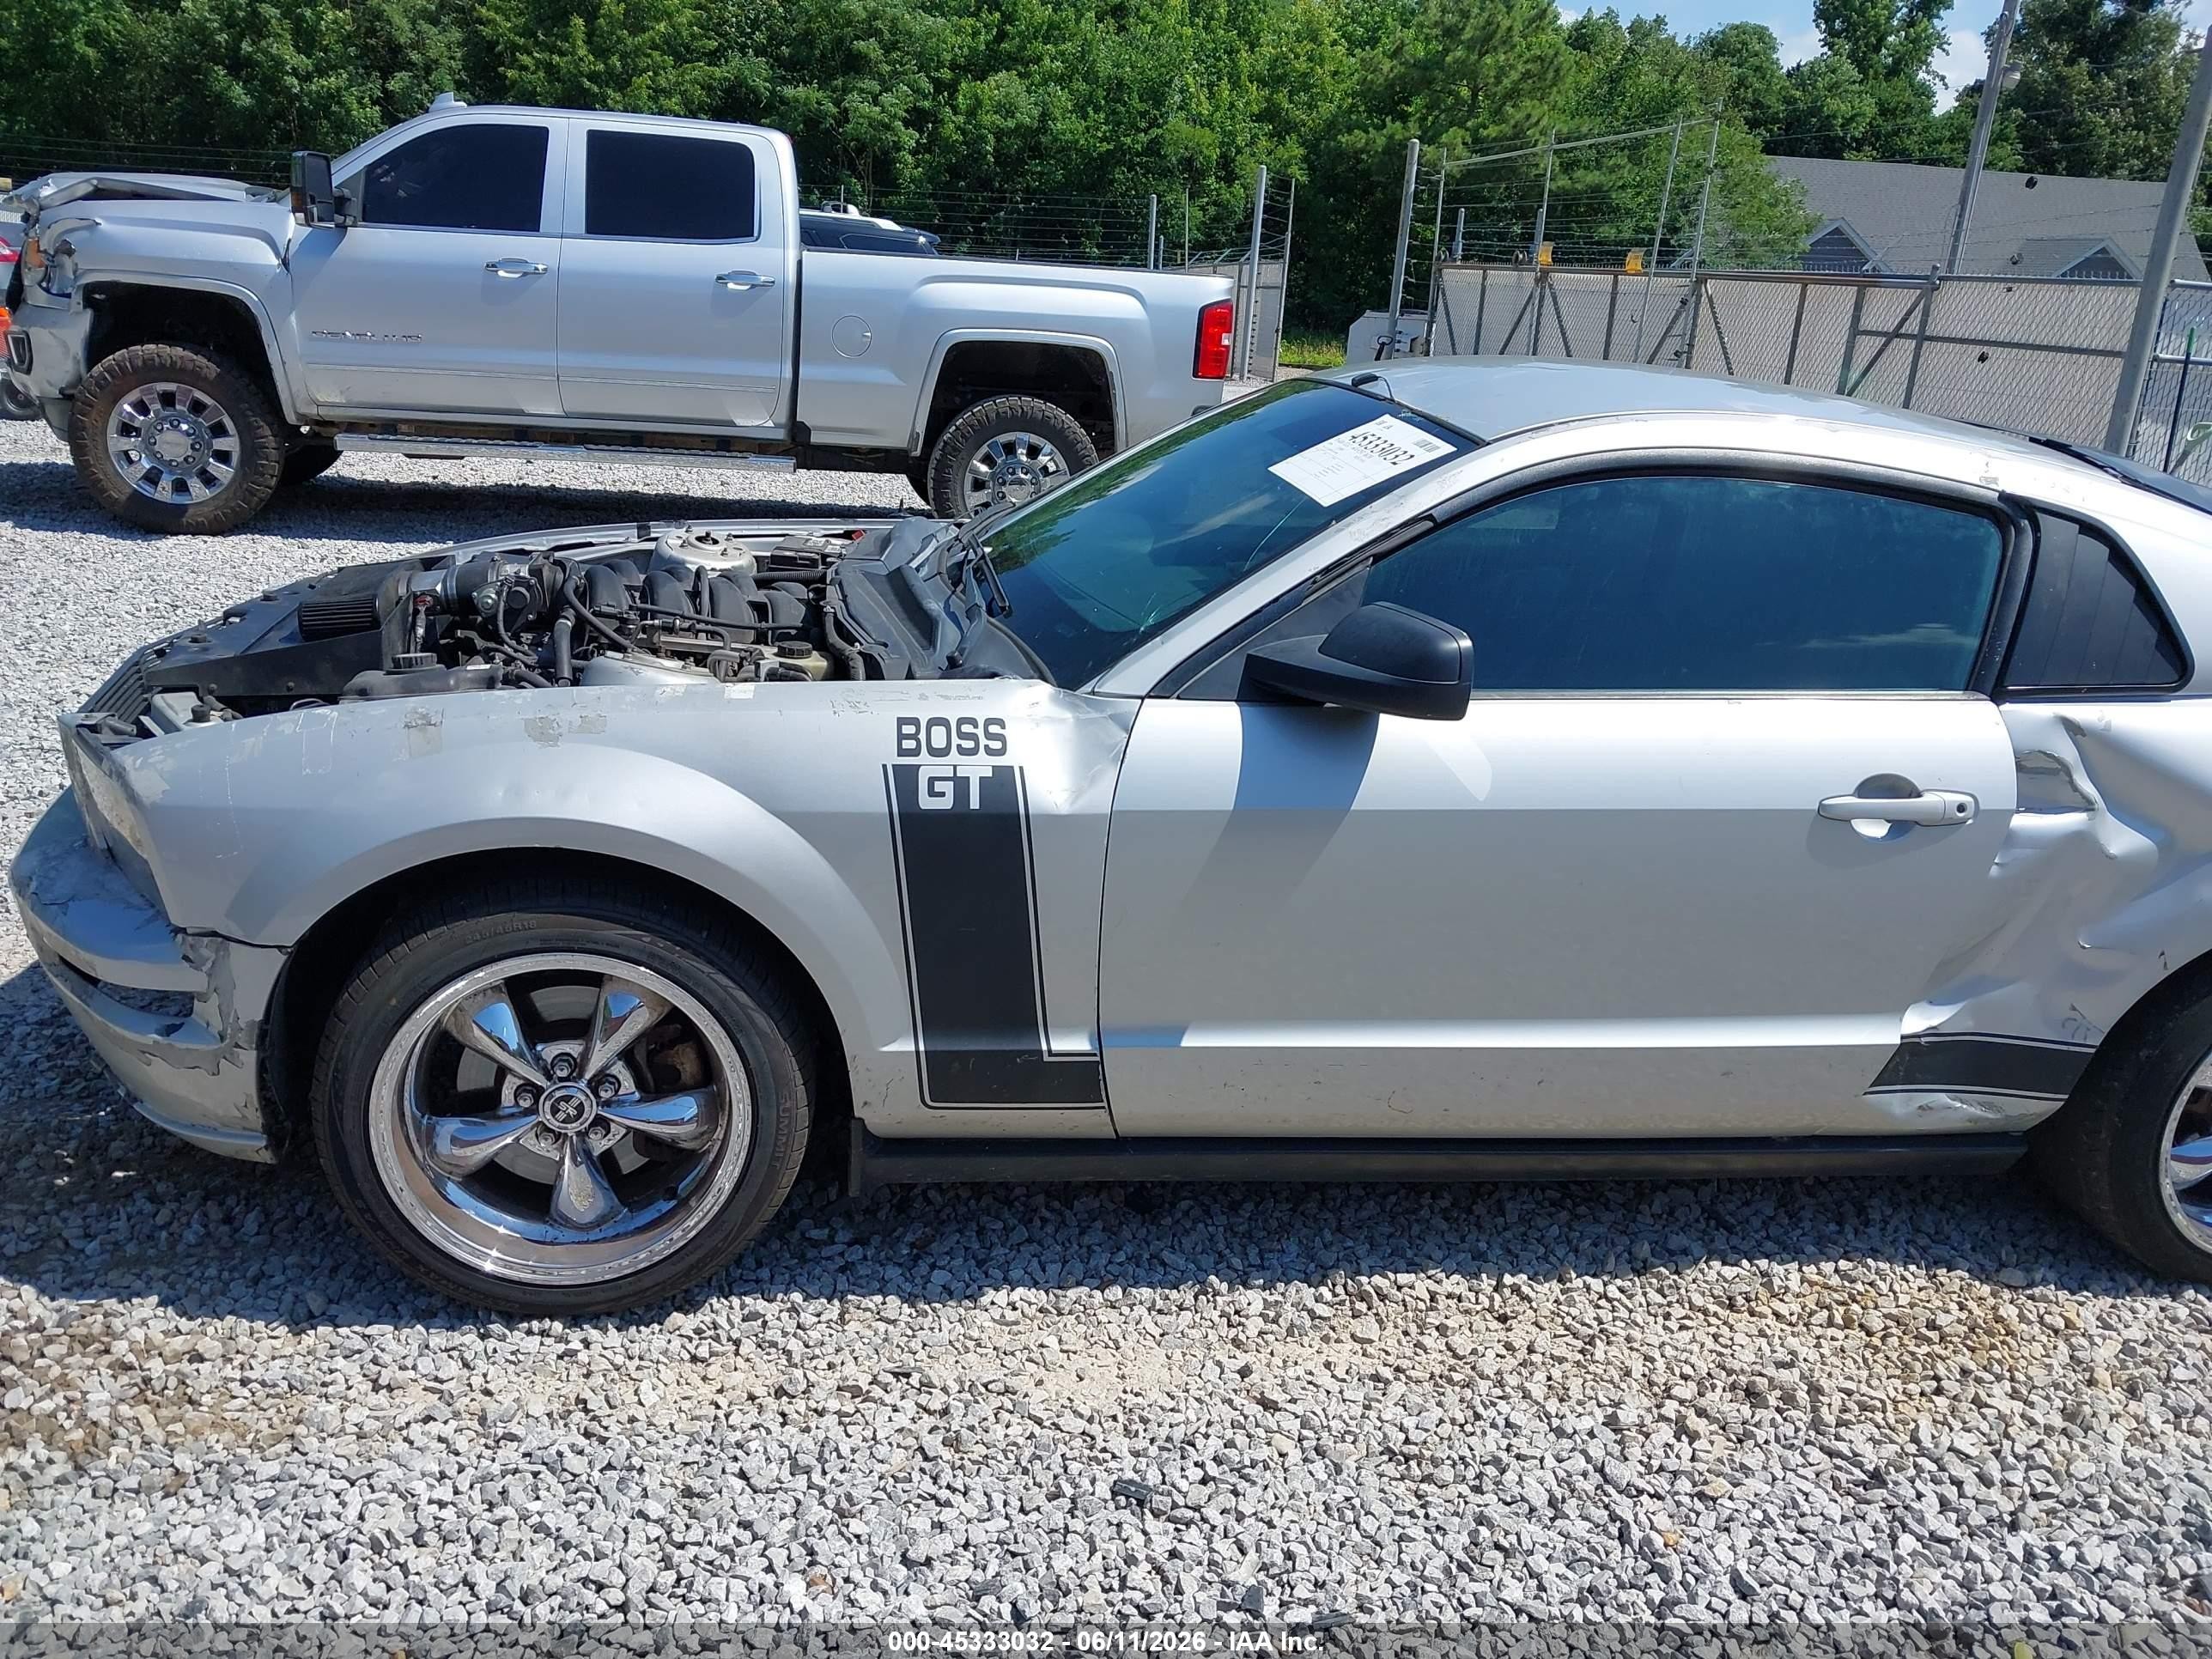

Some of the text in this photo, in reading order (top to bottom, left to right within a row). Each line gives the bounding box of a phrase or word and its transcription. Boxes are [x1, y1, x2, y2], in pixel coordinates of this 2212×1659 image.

[1346, 431, 1416, 466] 45333032
[896, 716, 1007, 757] BOSS
[918, 765, 993, 810] GT
[771, 1091, 791, 1169] SUMMIT
